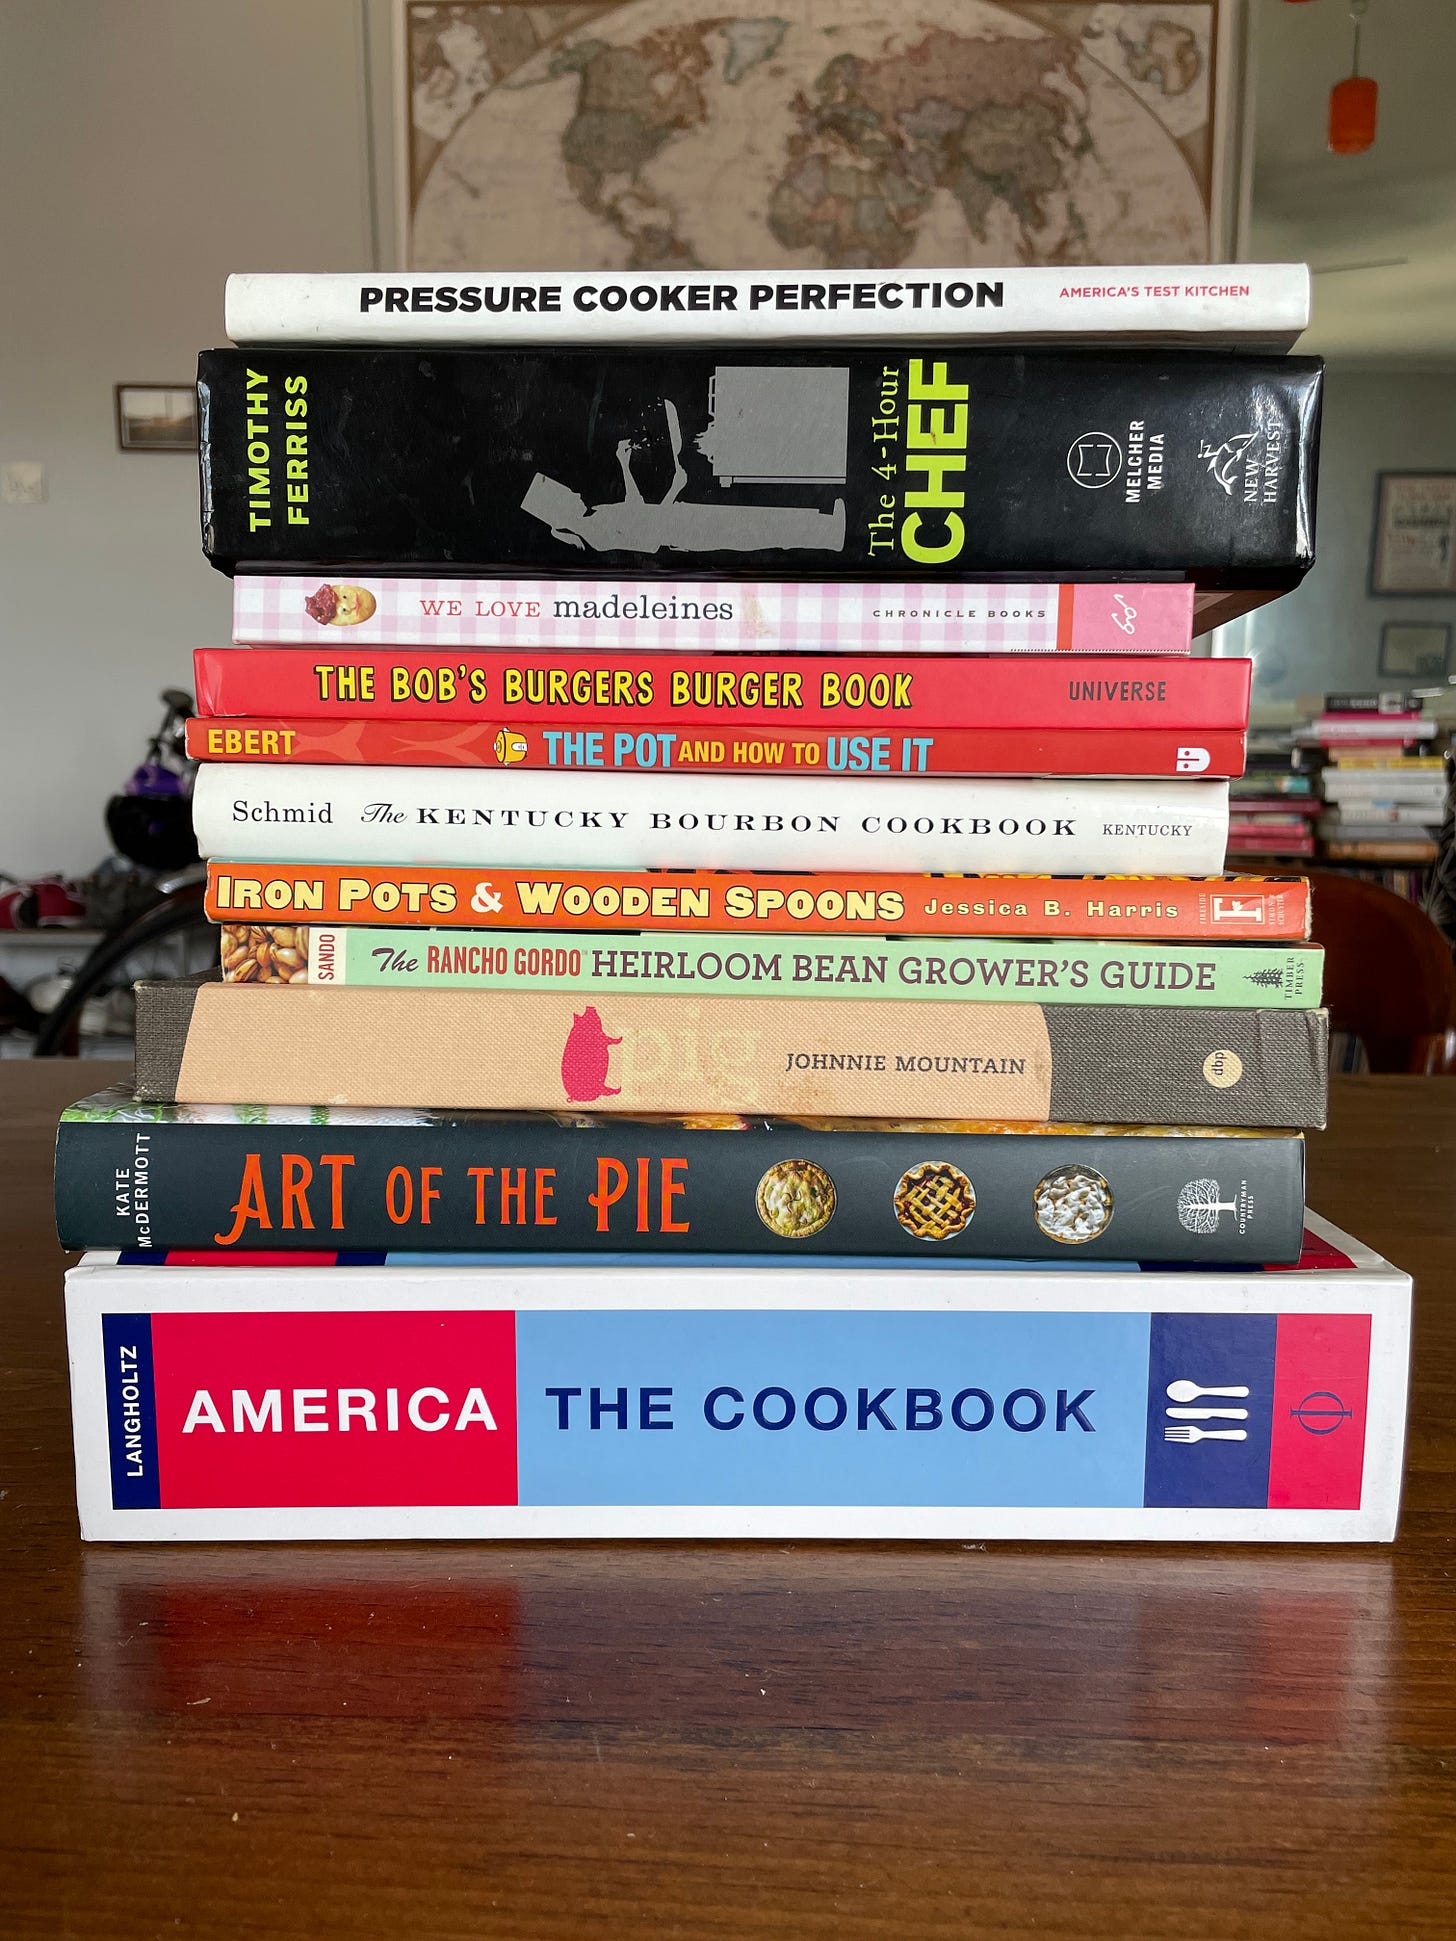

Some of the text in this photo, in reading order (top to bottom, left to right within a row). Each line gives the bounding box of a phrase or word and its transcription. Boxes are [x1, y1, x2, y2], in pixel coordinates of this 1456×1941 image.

[360, 282, 1004, 313] PRESSURE COOKER PERFECTION
[1059, 285, 1250, 299] AMERICA'S TEST KITCHEN
[246, 368, 272, 532] TIMOTHY
[284, 375, 310, 525] FERRISS
[867, 366, 900, 557] The 4-Hour
[900, 358, 970, 564] CHEF
[1125, 420, 1145, 504] MELCHER
[1146, 433, 1166, 490] MEDIA
[1263, 419, 1283, 505] HARVEST
[1243, 458, 1260, 505] NEW
[420, 595, 734, 620] WE LOVE madeleines
[872, 609, 1047, 618] CHRONICLE BOOKS
[314, 664, 914, 710] THE BOB'S BURGERS BURGER BOOK
[1068, 681, 1167, 702] UNIVERSE
[207, 729, 296, 755] EBERT
[543, 731, 934, 772] THE POT AND HOW TO USE IT
[232, 800, 333, 824] Schmid
[360, 803, 1077, 836] The KENTUCKY BOURBON COOKBOOK
[1102, 823, 1193, 837] KENTUCKY
[216, 875, 905, 921] IRON POTS & WOODEN SPOONS
[924, 898, 1180, 919] Jessica B. Harris
[316, 934, 335, 980] SANDO
[371, 946, 1217, 990] The RANCHO GORDO HEIRLOOM BEAN GROWER'S GUIDE
[1284, 957, 1295, 1000] TIMBER
[1294, 961, 1305, 995] PRESS
[619, 1004, 764, 1108] pig
[785, 1053, 1026, 1075] JOHNNIE MOUNTAIN
[1211, 1052, 1227, 1076] dbp
[115, 1168, 131, 1216] KATE
[134, 1132, 153, 1248] McDERMOTT
[214, 1153, 690, 1245] ART OF THE PIE
[1238, 1179, 1247, 1235] COUNTRYMAN
[125, 1345, 143, 1478] LANGHOLTZ
[181, 1386, 1097, 1433] AMERICA THE COOKBOOK
